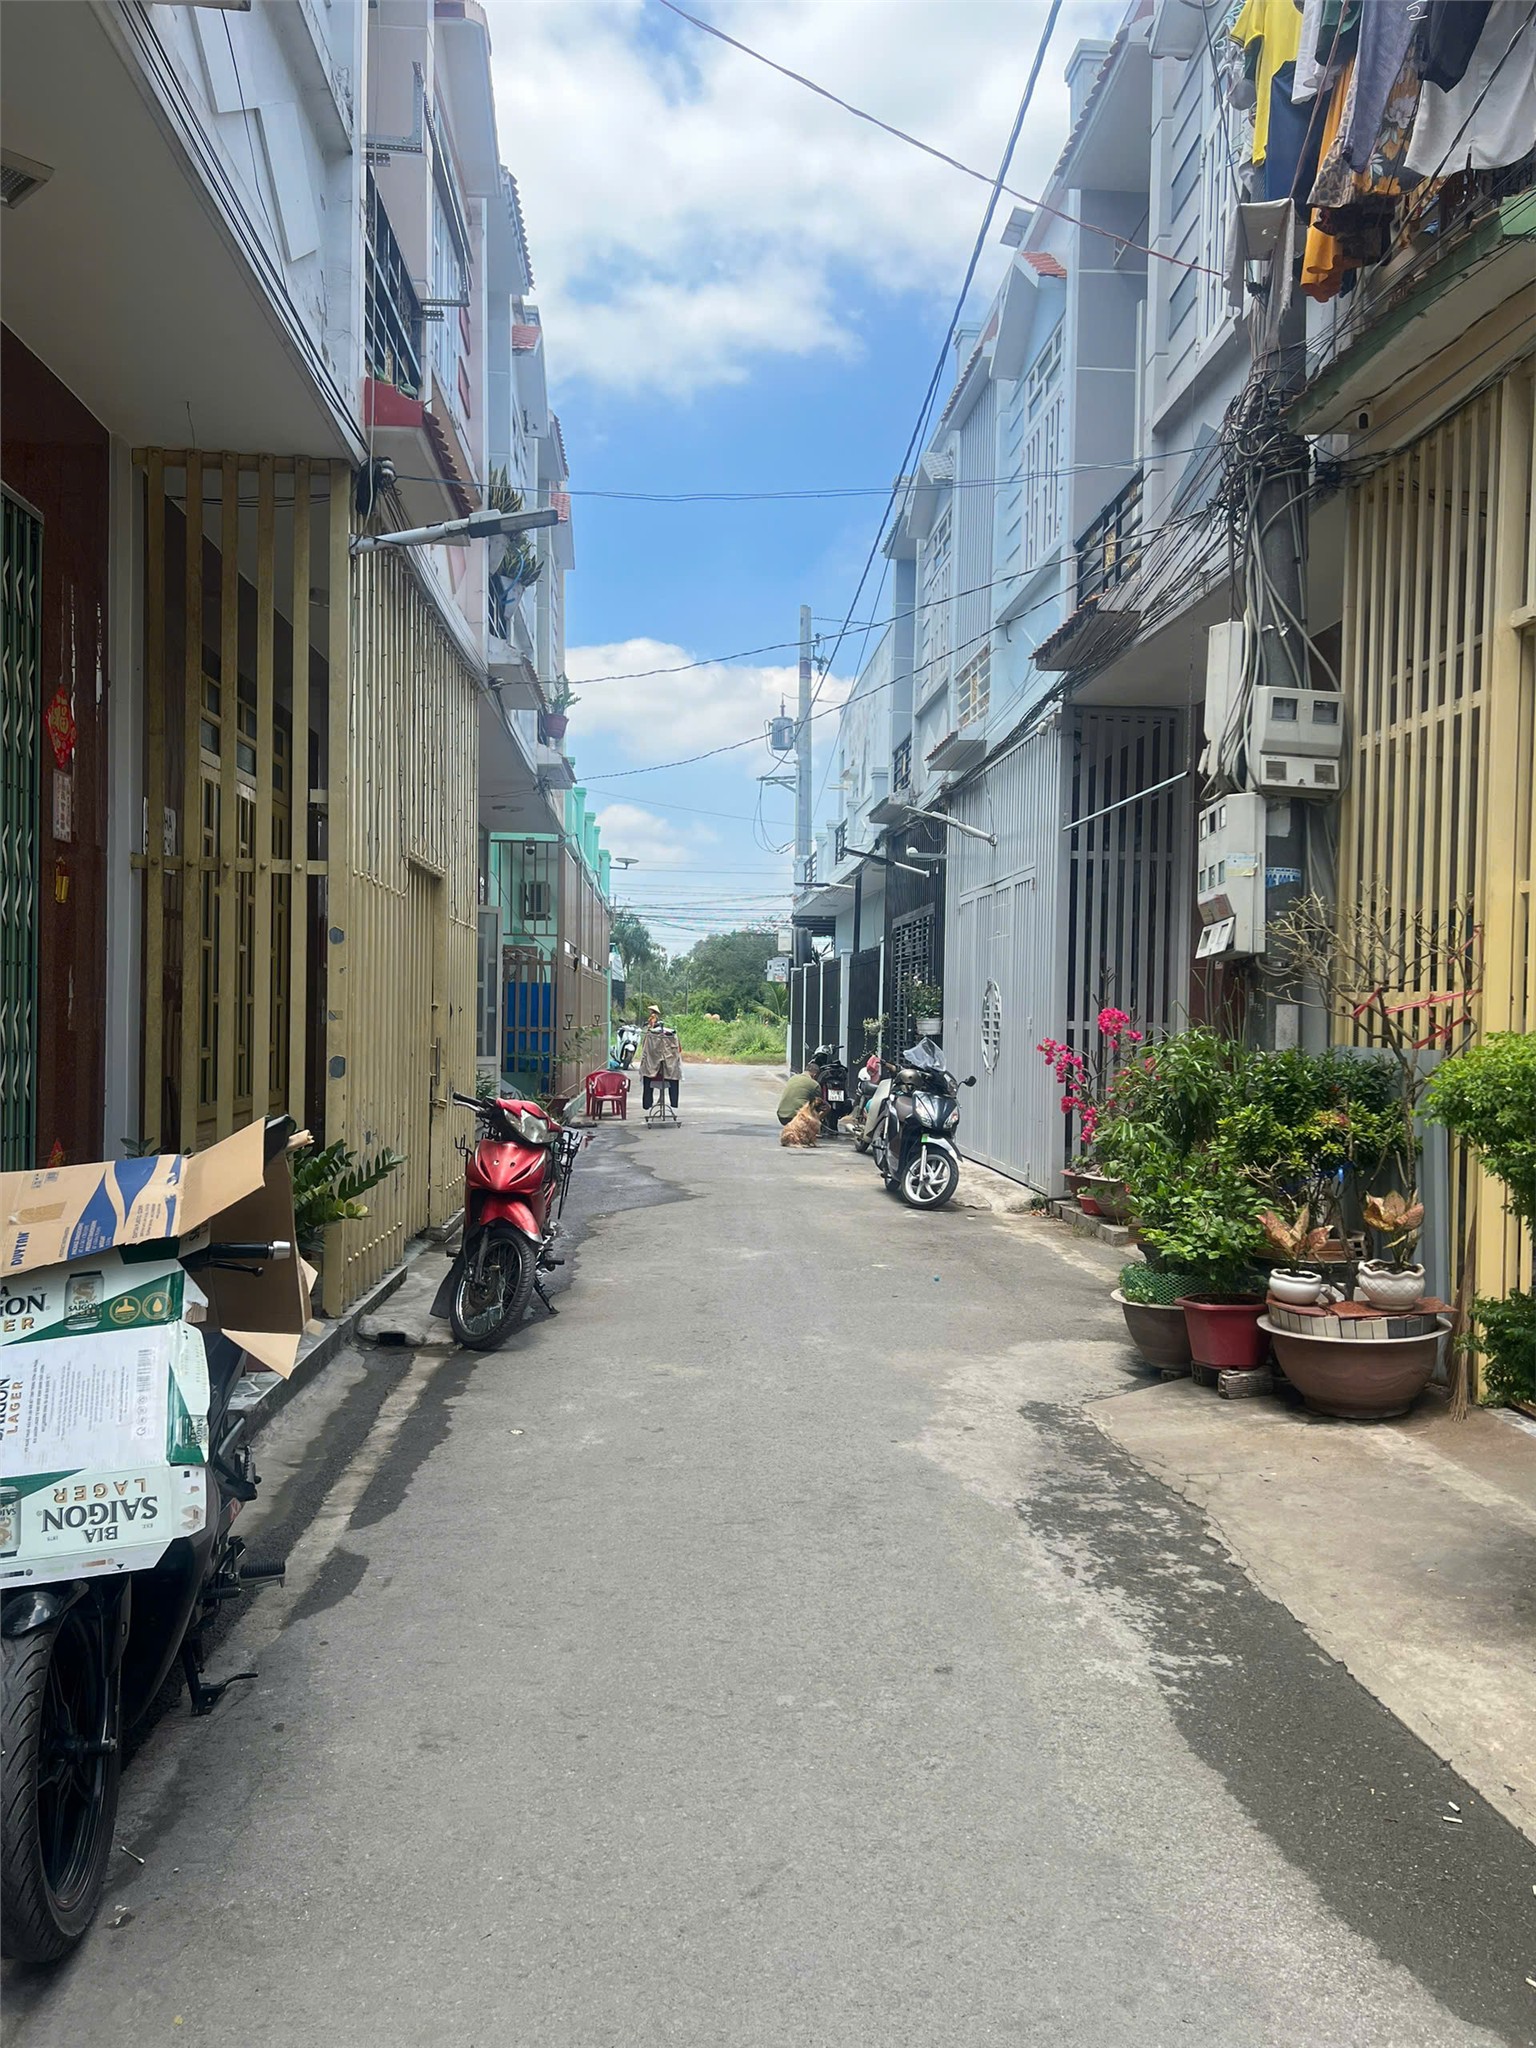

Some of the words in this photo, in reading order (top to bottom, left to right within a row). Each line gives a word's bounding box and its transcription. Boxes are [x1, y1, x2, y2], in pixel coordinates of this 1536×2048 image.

[6, 1381, 23, 1435] LAGER
[54, 1478, 147, 1504] LAGER
[41, 1496, 158, 1533] SAIGON
[83, 1525, 118, 1543] BIA
